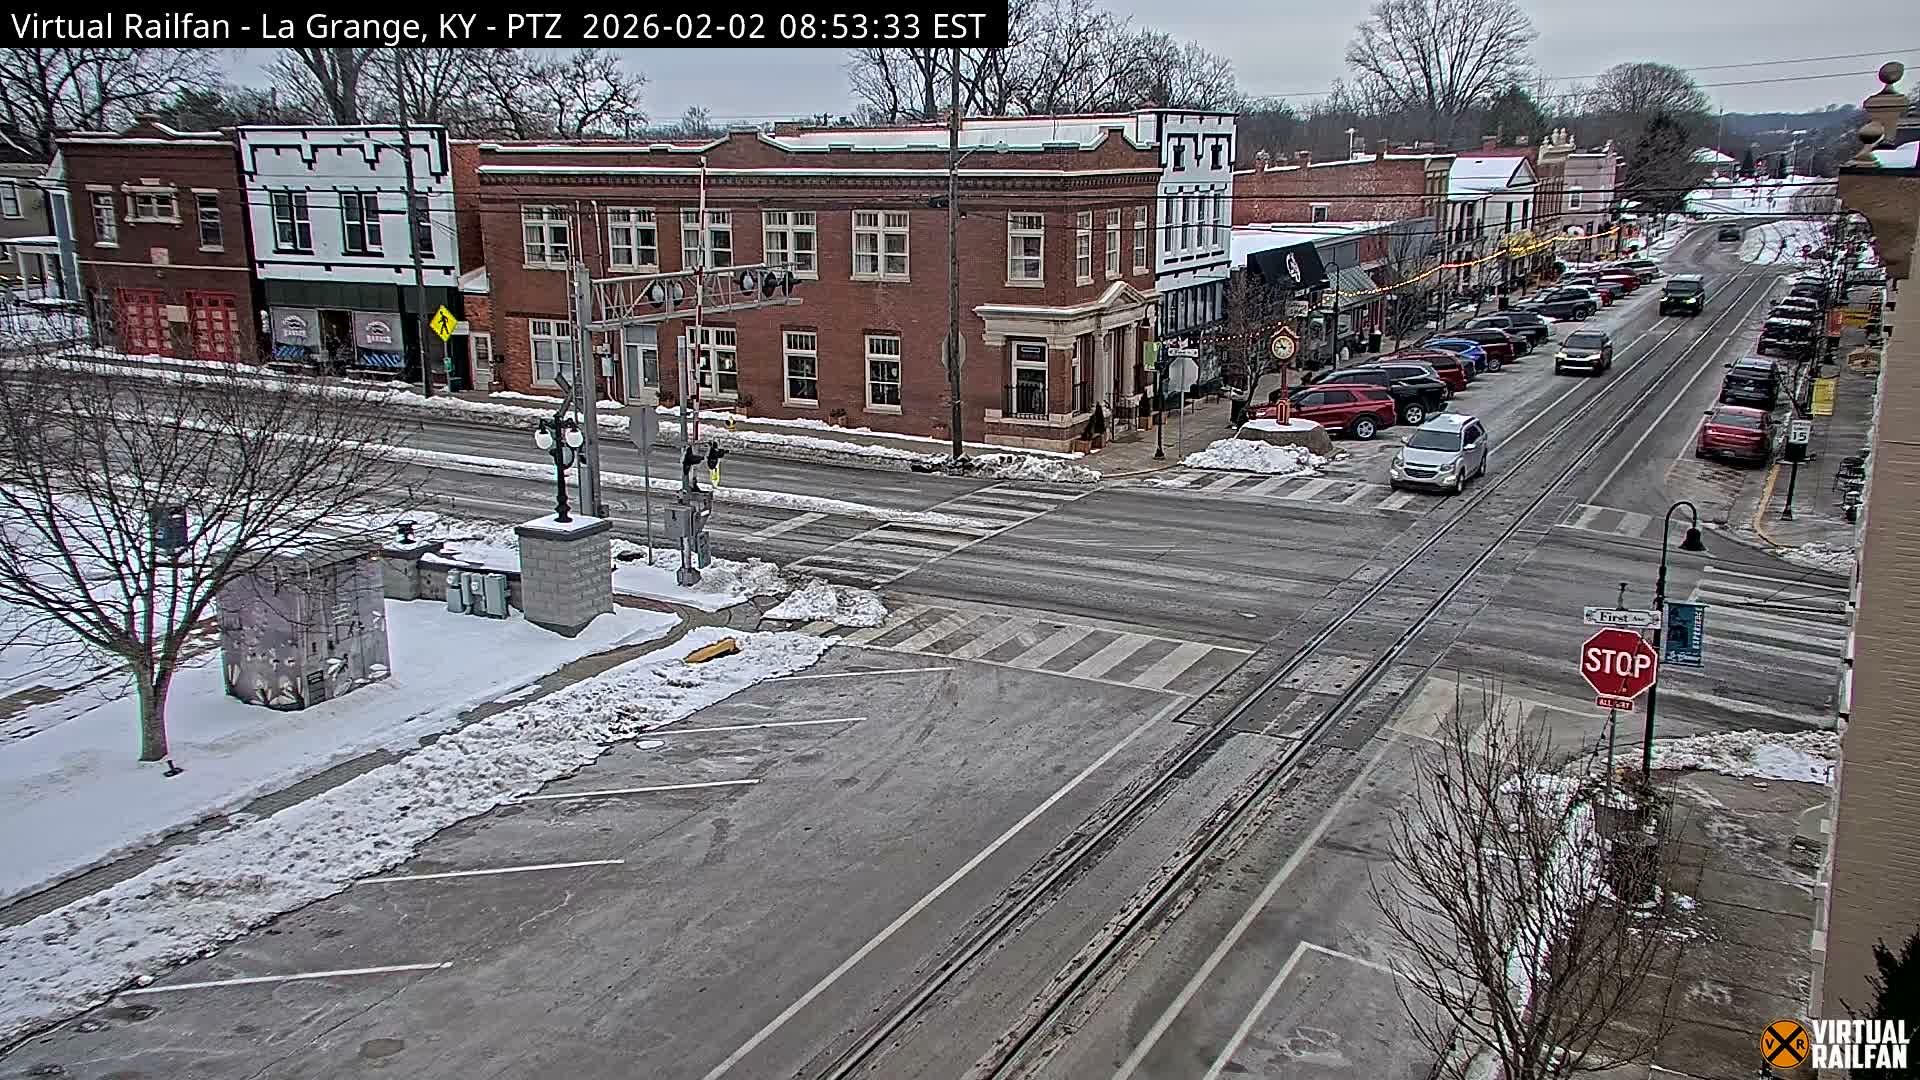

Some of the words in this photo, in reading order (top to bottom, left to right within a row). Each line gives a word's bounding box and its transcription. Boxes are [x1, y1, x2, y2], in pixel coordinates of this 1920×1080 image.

[1793, 431, 1807, 442] 15
[1600, 611, 1628, 623] First
[1585, 647, 1652, 678] STOP
